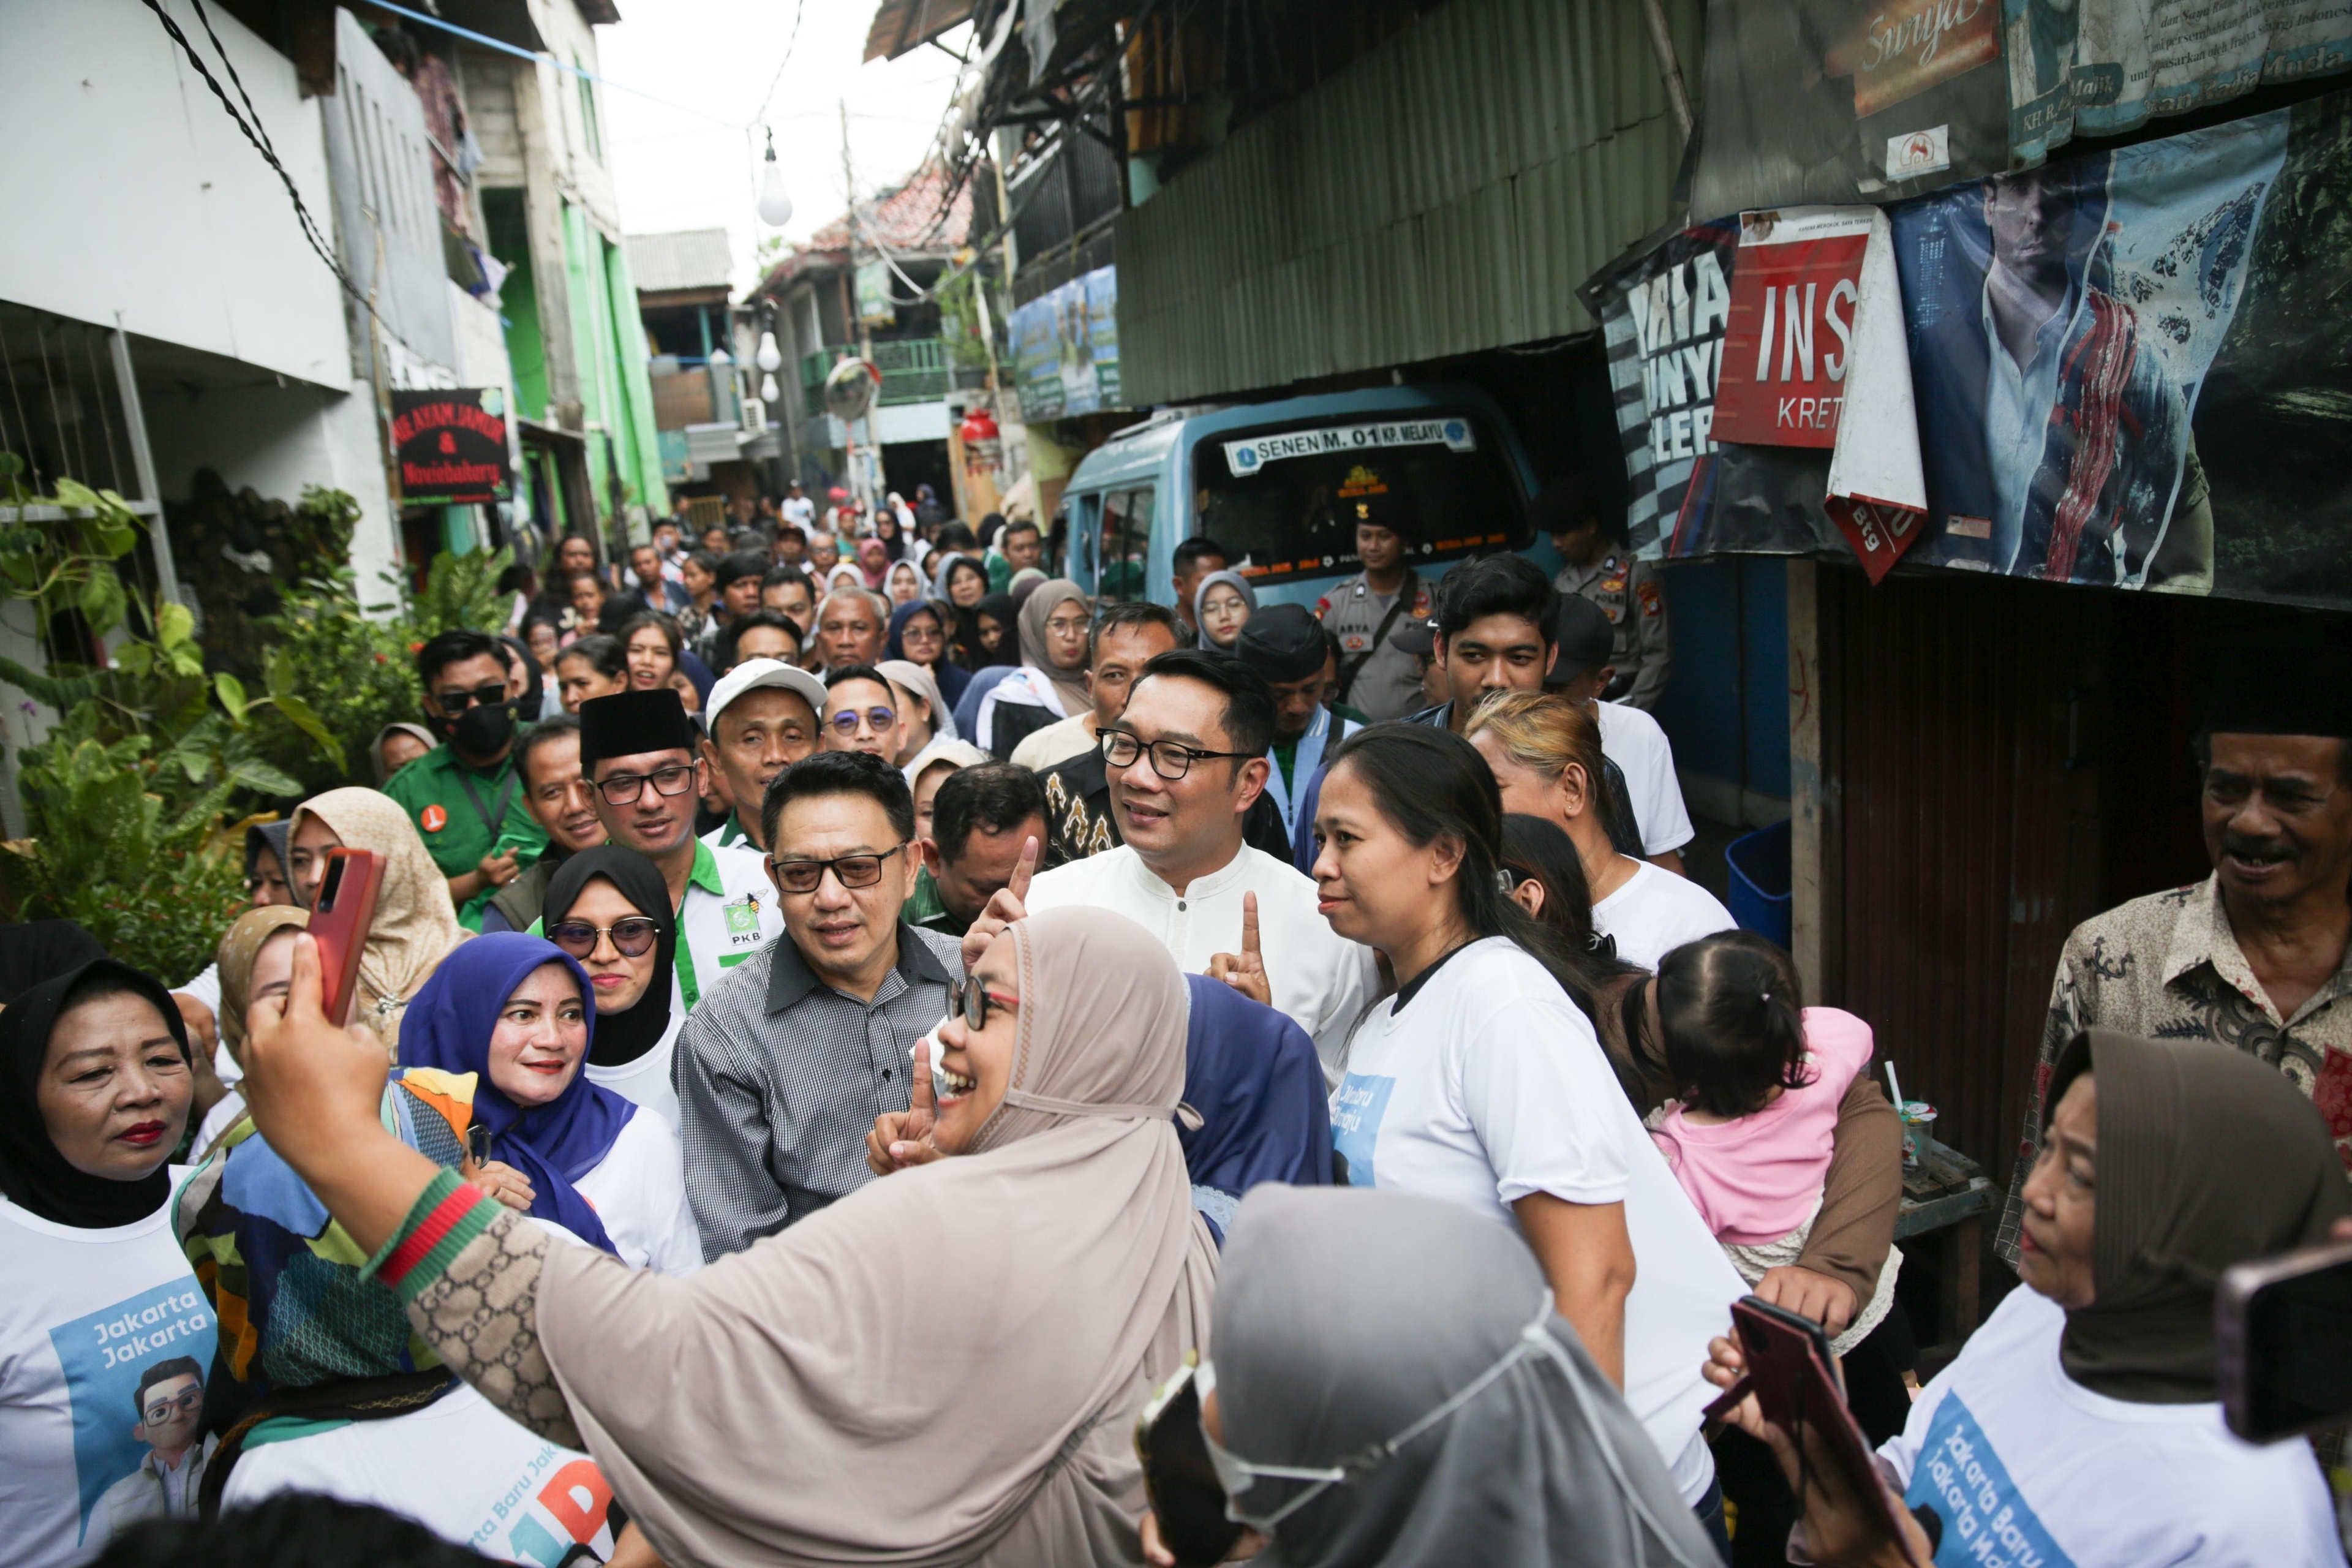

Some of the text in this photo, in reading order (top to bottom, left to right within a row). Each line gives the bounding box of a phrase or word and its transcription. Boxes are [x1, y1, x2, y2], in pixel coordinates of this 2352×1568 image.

[1861, 0, 1982, 72] Surya
[2207, 42, 2227, 57] oleh
[2263, 47, 2345, 77] Muda
[411, 402, 455, 433] AYAM
[1257, 435, 1320, 459] SENEN
[1322, 432, 1346, 450] M.
[1352, 429, 1379, 447] 01
[1401, 423, 1443, 440] MELAYU
[1852, 504, 1880, 552] Btg
[1594, 594, 1624, 605] POLRI
[1340, 624, 1370, 633] ARYA
[732, 932, 760, 944] PKB
[94, 1291, 198, 1345] Jakarta
[102, 1313, 208, 1370] Jakarta
[492, 1474, 532, 1520] Baru
[1927, 1448, 1978, 1540] Jakarta
[1945, 1424, 2043, 1568] Jakarta Baru
